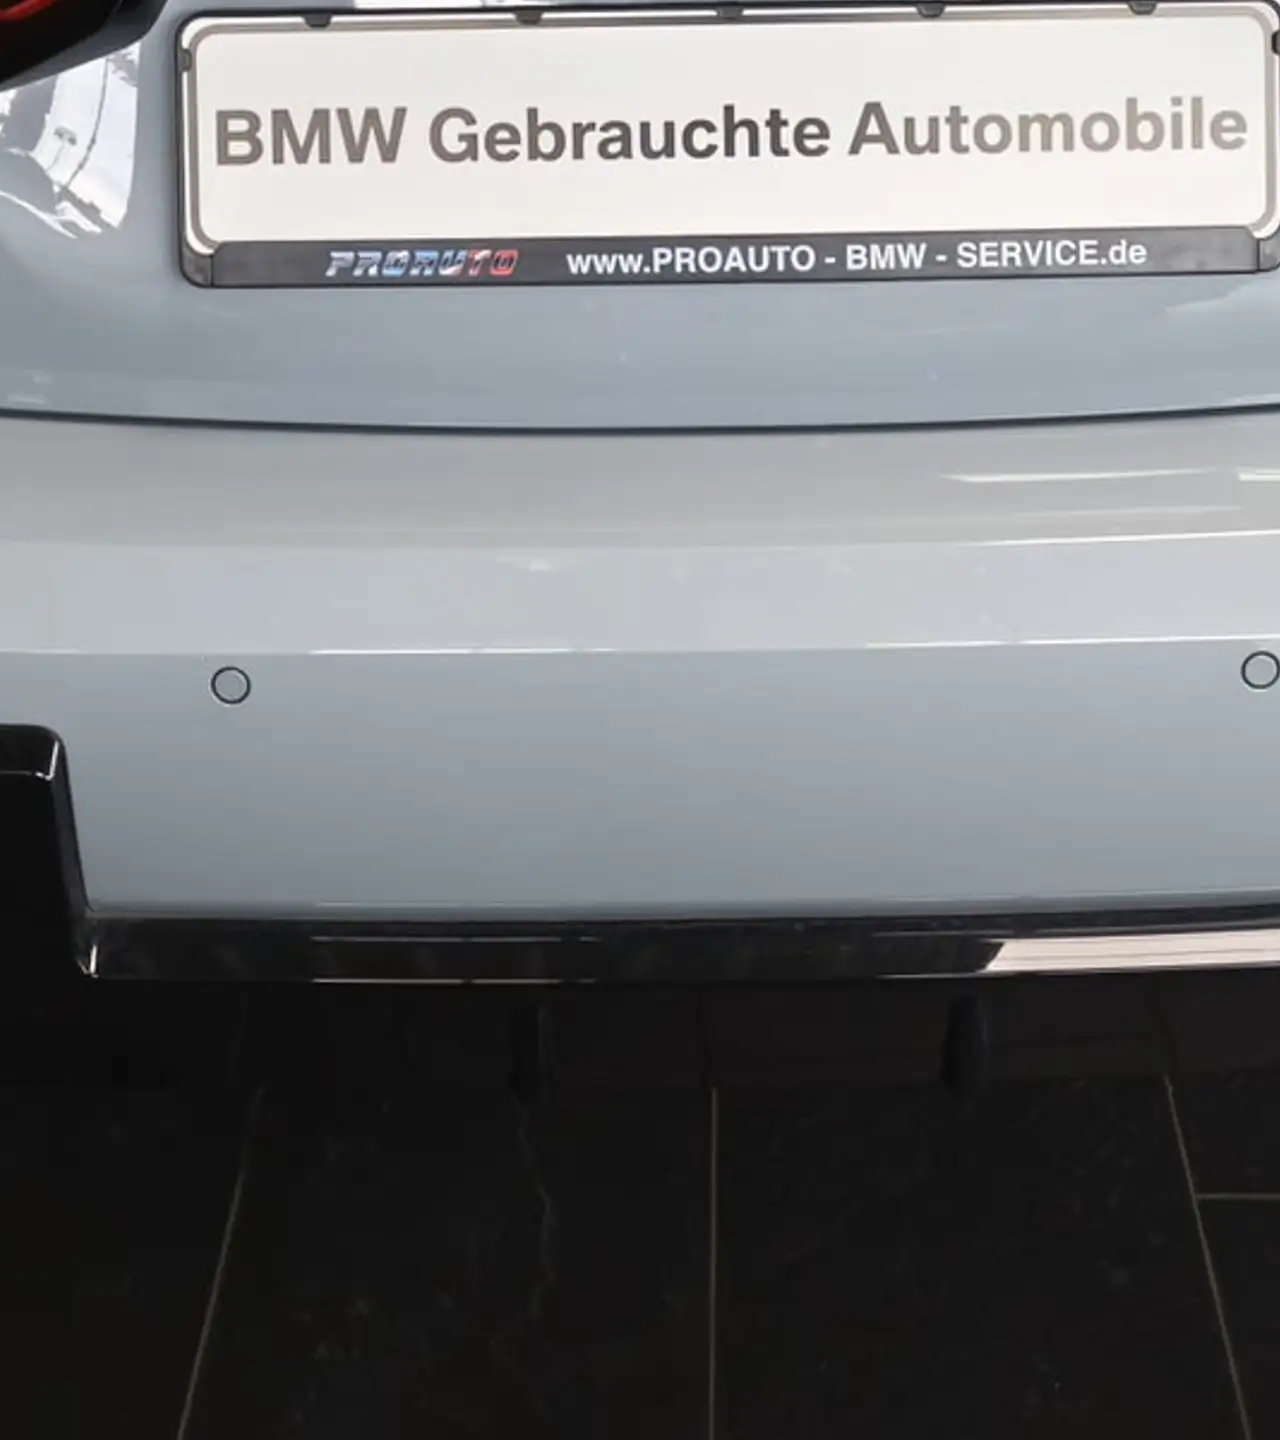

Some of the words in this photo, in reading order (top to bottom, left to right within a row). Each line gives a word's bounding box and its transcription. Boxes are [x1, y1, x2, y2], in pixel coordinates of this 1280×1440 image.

[214, 107, 407, 166] BMW
[428, 103, 831, 163] Gebrauchte
[848, 95, 1249, 156] Automobile
[565, 245, 816, 275] www.PROAUTO
[845, 243, 928, 270] BMW
[955, 239, 1148, 268] SERVICE.de
